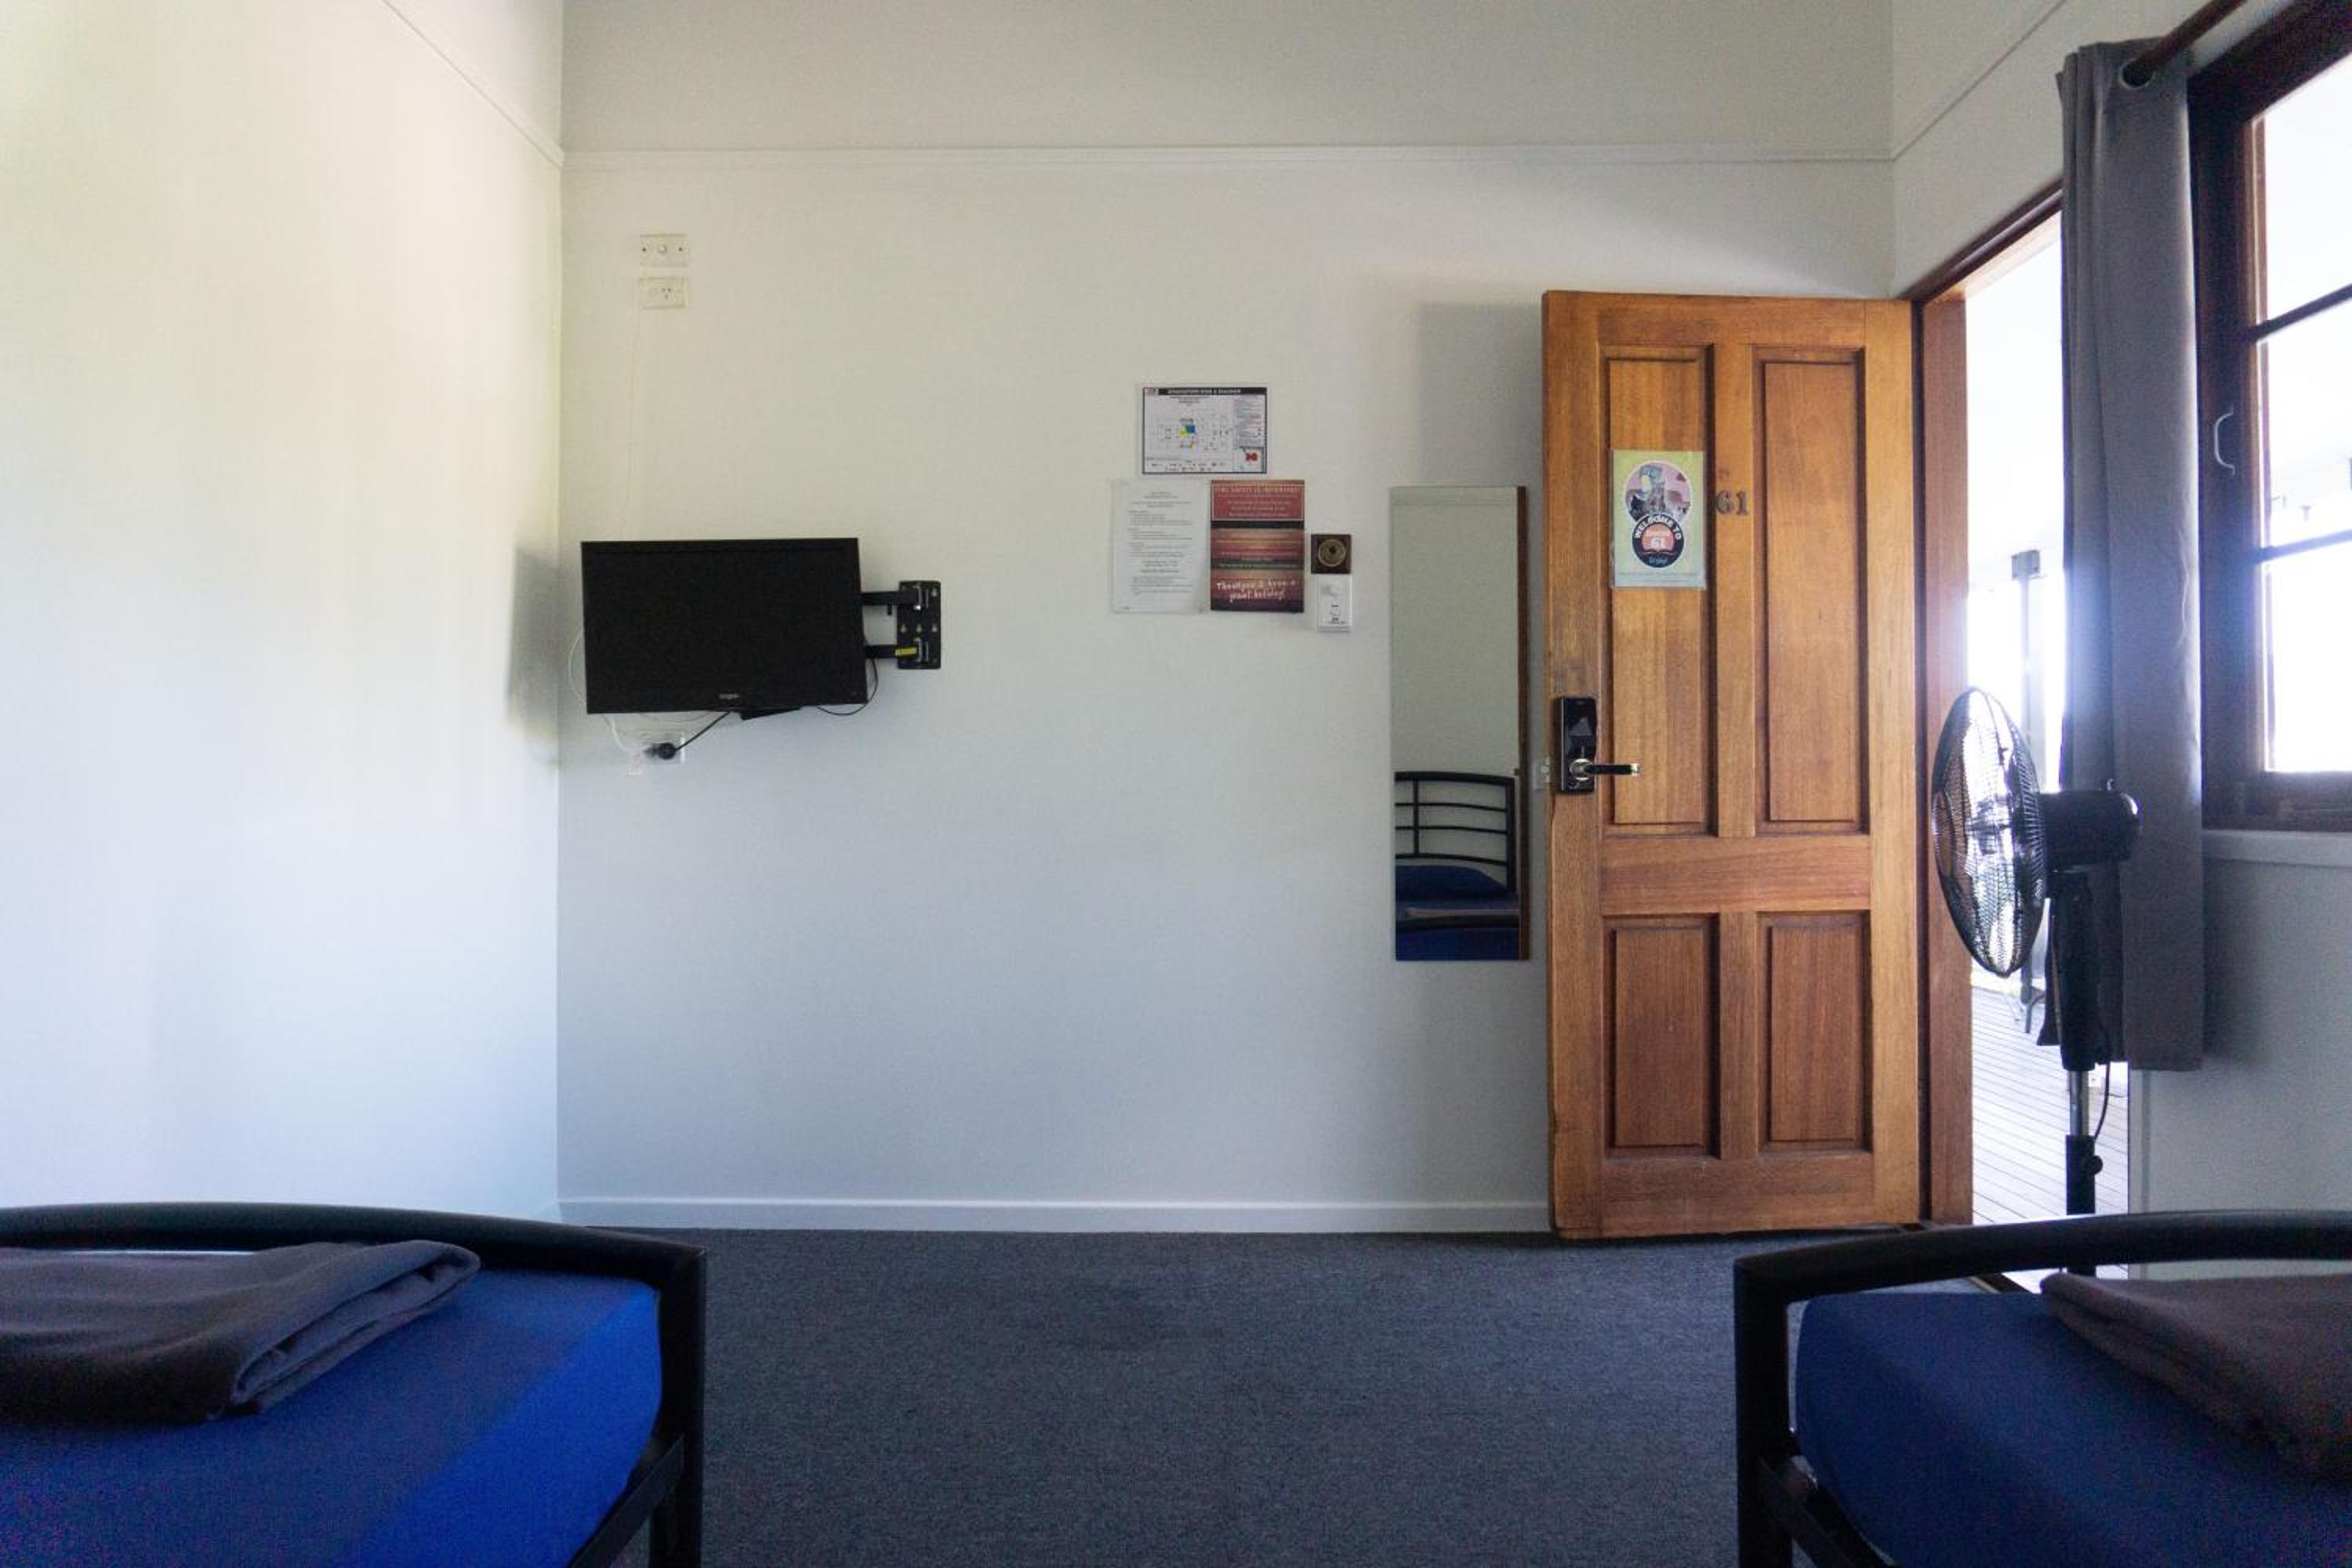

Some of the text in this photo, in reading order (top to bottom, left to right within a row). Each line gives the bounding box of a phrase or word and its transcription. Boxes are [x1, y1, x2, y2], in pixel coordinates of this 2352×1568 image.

[1716, 490, 1748, 515] 61
[1635, 514, 1682, 539] WELCOME TO
